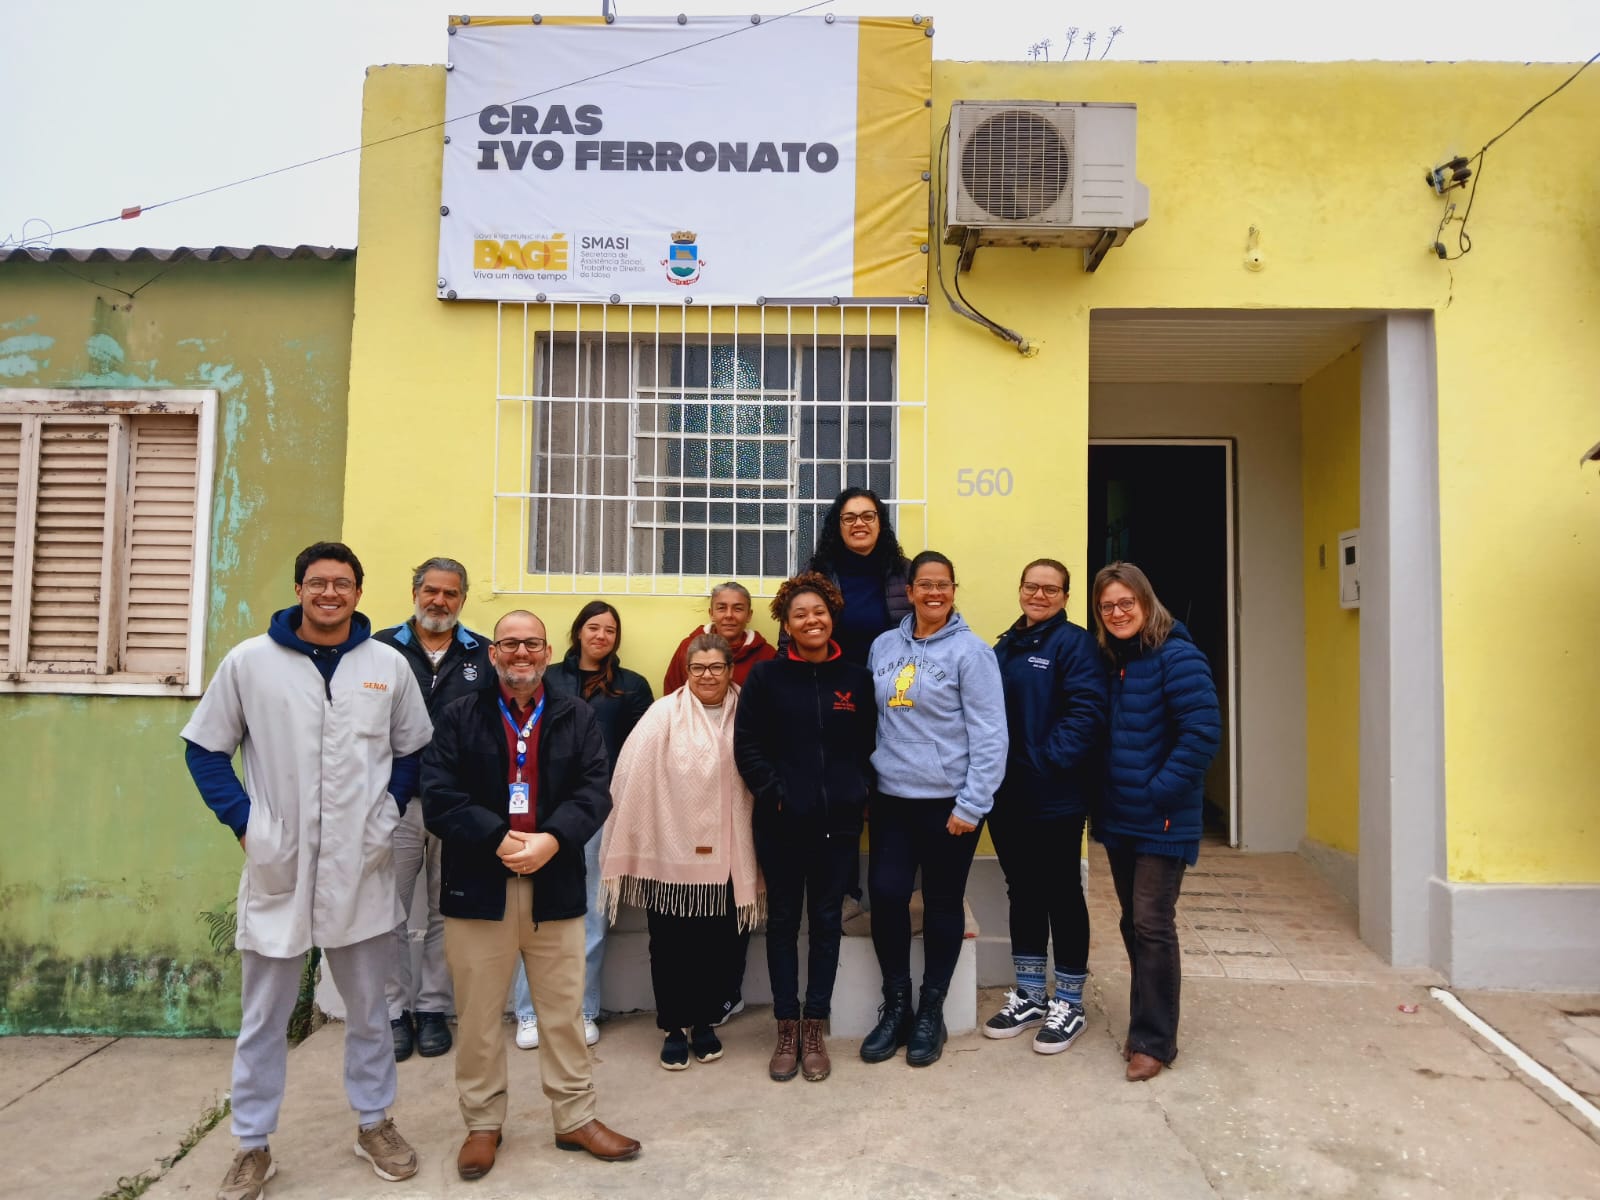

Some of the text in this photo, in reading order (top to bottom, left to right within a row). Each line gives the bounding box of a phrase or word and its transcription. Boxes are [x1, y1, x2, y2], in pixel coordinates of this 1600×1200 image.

[478, 104, 603, 135] CRAS
[477, 140, 839, 173] IVO FERRONATO
[511, 232, 549, 240] MUNICIPAL
[581, 236, 629, 250] SMASI
[474, 233, 568, 270] BAGÉ
[580, 250, 617, 258] Secretaria
[580, 264, 611, 272] Trabalho
[473, 271, 493, 279] Viva
[537, 272, 567, 281] tempo
[957, 467, 1013, 497] 560
[363, 682, 388, 691] SENAI
